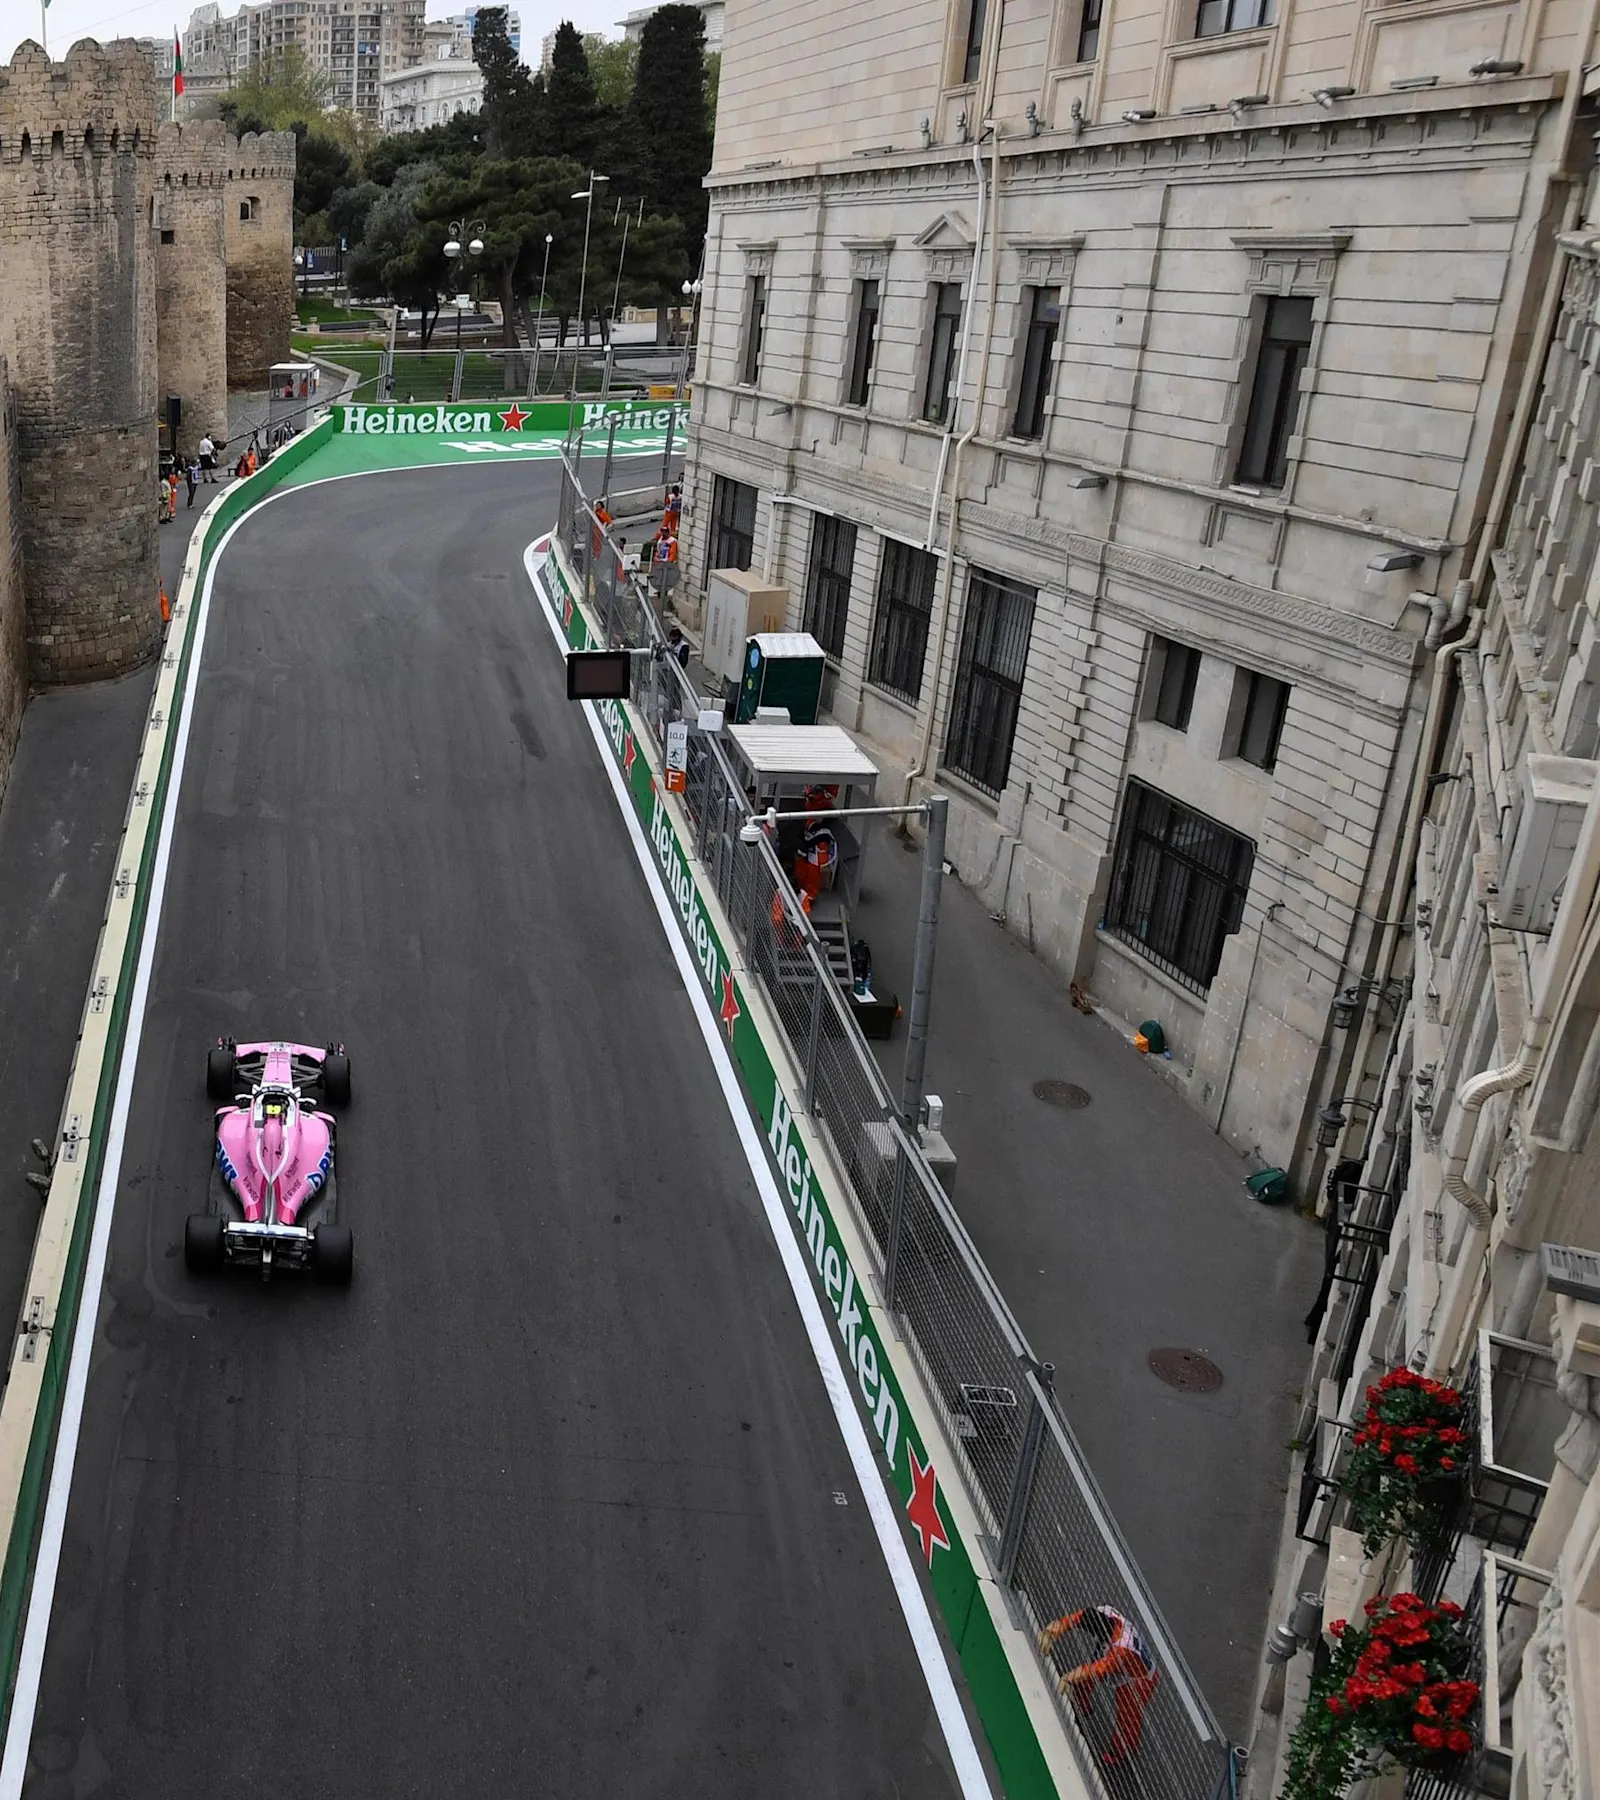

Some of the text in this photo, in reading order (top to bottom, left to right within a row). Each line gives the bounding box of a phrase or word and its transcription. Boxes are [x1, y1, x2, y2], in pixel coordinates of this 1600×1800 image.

[341, 406, 492, 434] Heineken
[667, 771, 681, 788] F
[650, 788, 718, 995] Heineken
[768, 1080, 899, 1470] Heineken
